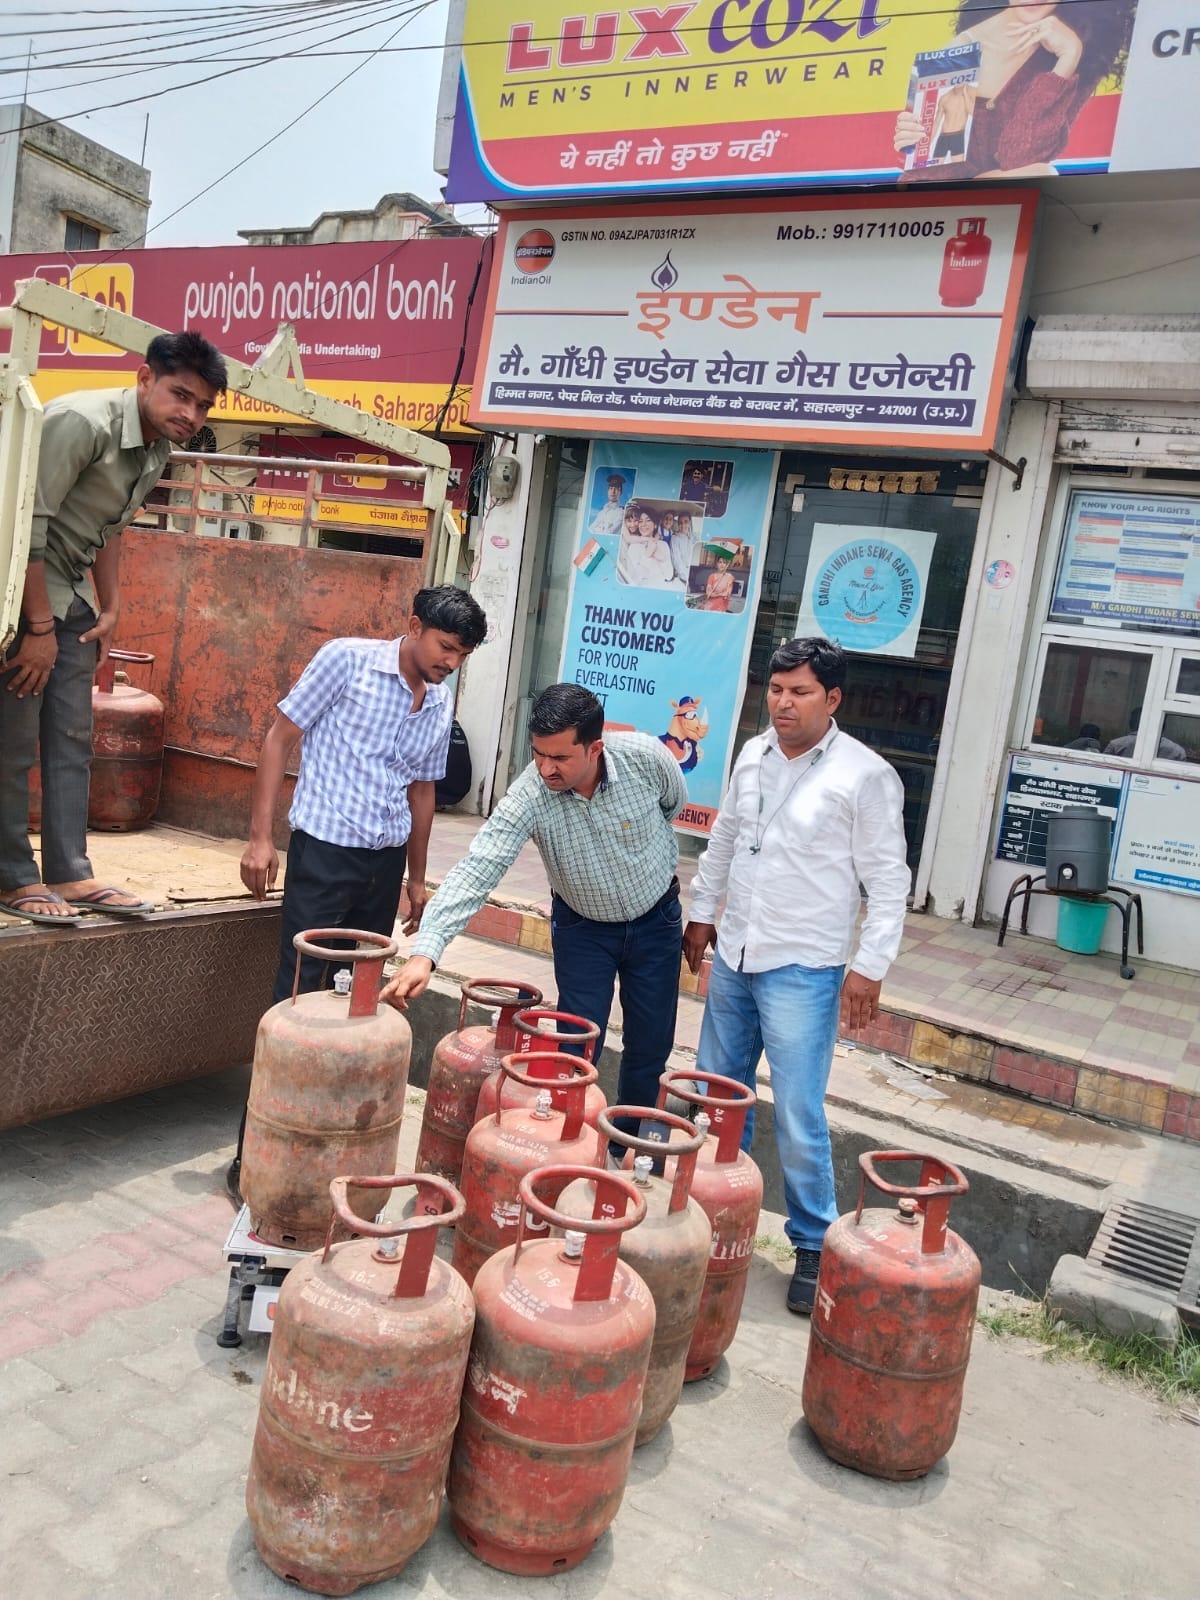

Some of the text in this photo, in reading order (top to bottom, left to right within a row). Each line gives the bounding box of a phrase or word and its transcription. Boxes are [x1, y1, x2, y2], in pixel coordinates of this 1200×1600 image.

[506, 2, 698, 73] LUX
[925, 45, 973, 60] LUX COZI
[500, 58, 885, 109] MEN'S INNERWEAR
[920, 79, 947, 90] LUX
[560, 129, 781, 171] ये नहीं तो कुछ नहीं
[561, 228, 697, 242] GSTIN NO. 09AZJPA7031R1ZX
[777, 221, 945, 240] Mob.: 9917110005
[511, 275, 551, 285] IndianOil
[183, 266, 264, 334] punjab
[271, 264, 380, 321] national
[386, 262, 457, 320] bank
[636, 274, 821, 339] इण्डेन
[314, 343, 381, 358] Undertaking)
[541, 346, 607, 380] गाँधी
[614, 349, 699, 385] इण्डेन
[705, 350, 769, 385] सेवा
[776, 350, 840, 388] गैस
[849, 353, 975, 392] एजेन्सी
[372, 394, 470, 430] Saharanpu
[495, 386, 525, 399] हिम्मत
[528, 389, 554, 401] नगर,
[558, 388, 579, 402] पेपर
[581, 390, 602, 404] मिल
[605, 391, 626, 405] रोड,
[630, 393, 661, 406] पंजाब
[729, 397, 743, 410] के
[745, 398, 781, 412] बराबर
[803, 401, 864, 419] सहारनपुर
[880, 405, 917, 417] 247001
[922, 402, 967, 421] (उ.प्र.)
[262, 499, 286, 511] punjab
[320, 505, 340, 515] bank
[1081, 501, 1108, 509] KNOW
[1110, 503, 1135, 511] YOUR
[1156, 506, 1191, 515] RIGHTS
[832, 545, 864, 572] INDANE
[867, 545, 893, 563] SEWA
[892, 558, 909, 577] GAS
[818, 569, 836, 606] GANDHI
[897, 578, 914, 618] AGENCY
[585, 604, 674, 633] THANK YOU
[1108, 602, 1141, 615] GANDHI
[1144, 606, 1178, 618] INDANE
[582, 626, 676, 655] CUSTOMERS
[578, 649, 639, 671] FOR YOUR
[576, 669, 656, 695] EVERLASTING
[678, 809, 711, 827] GENCY
